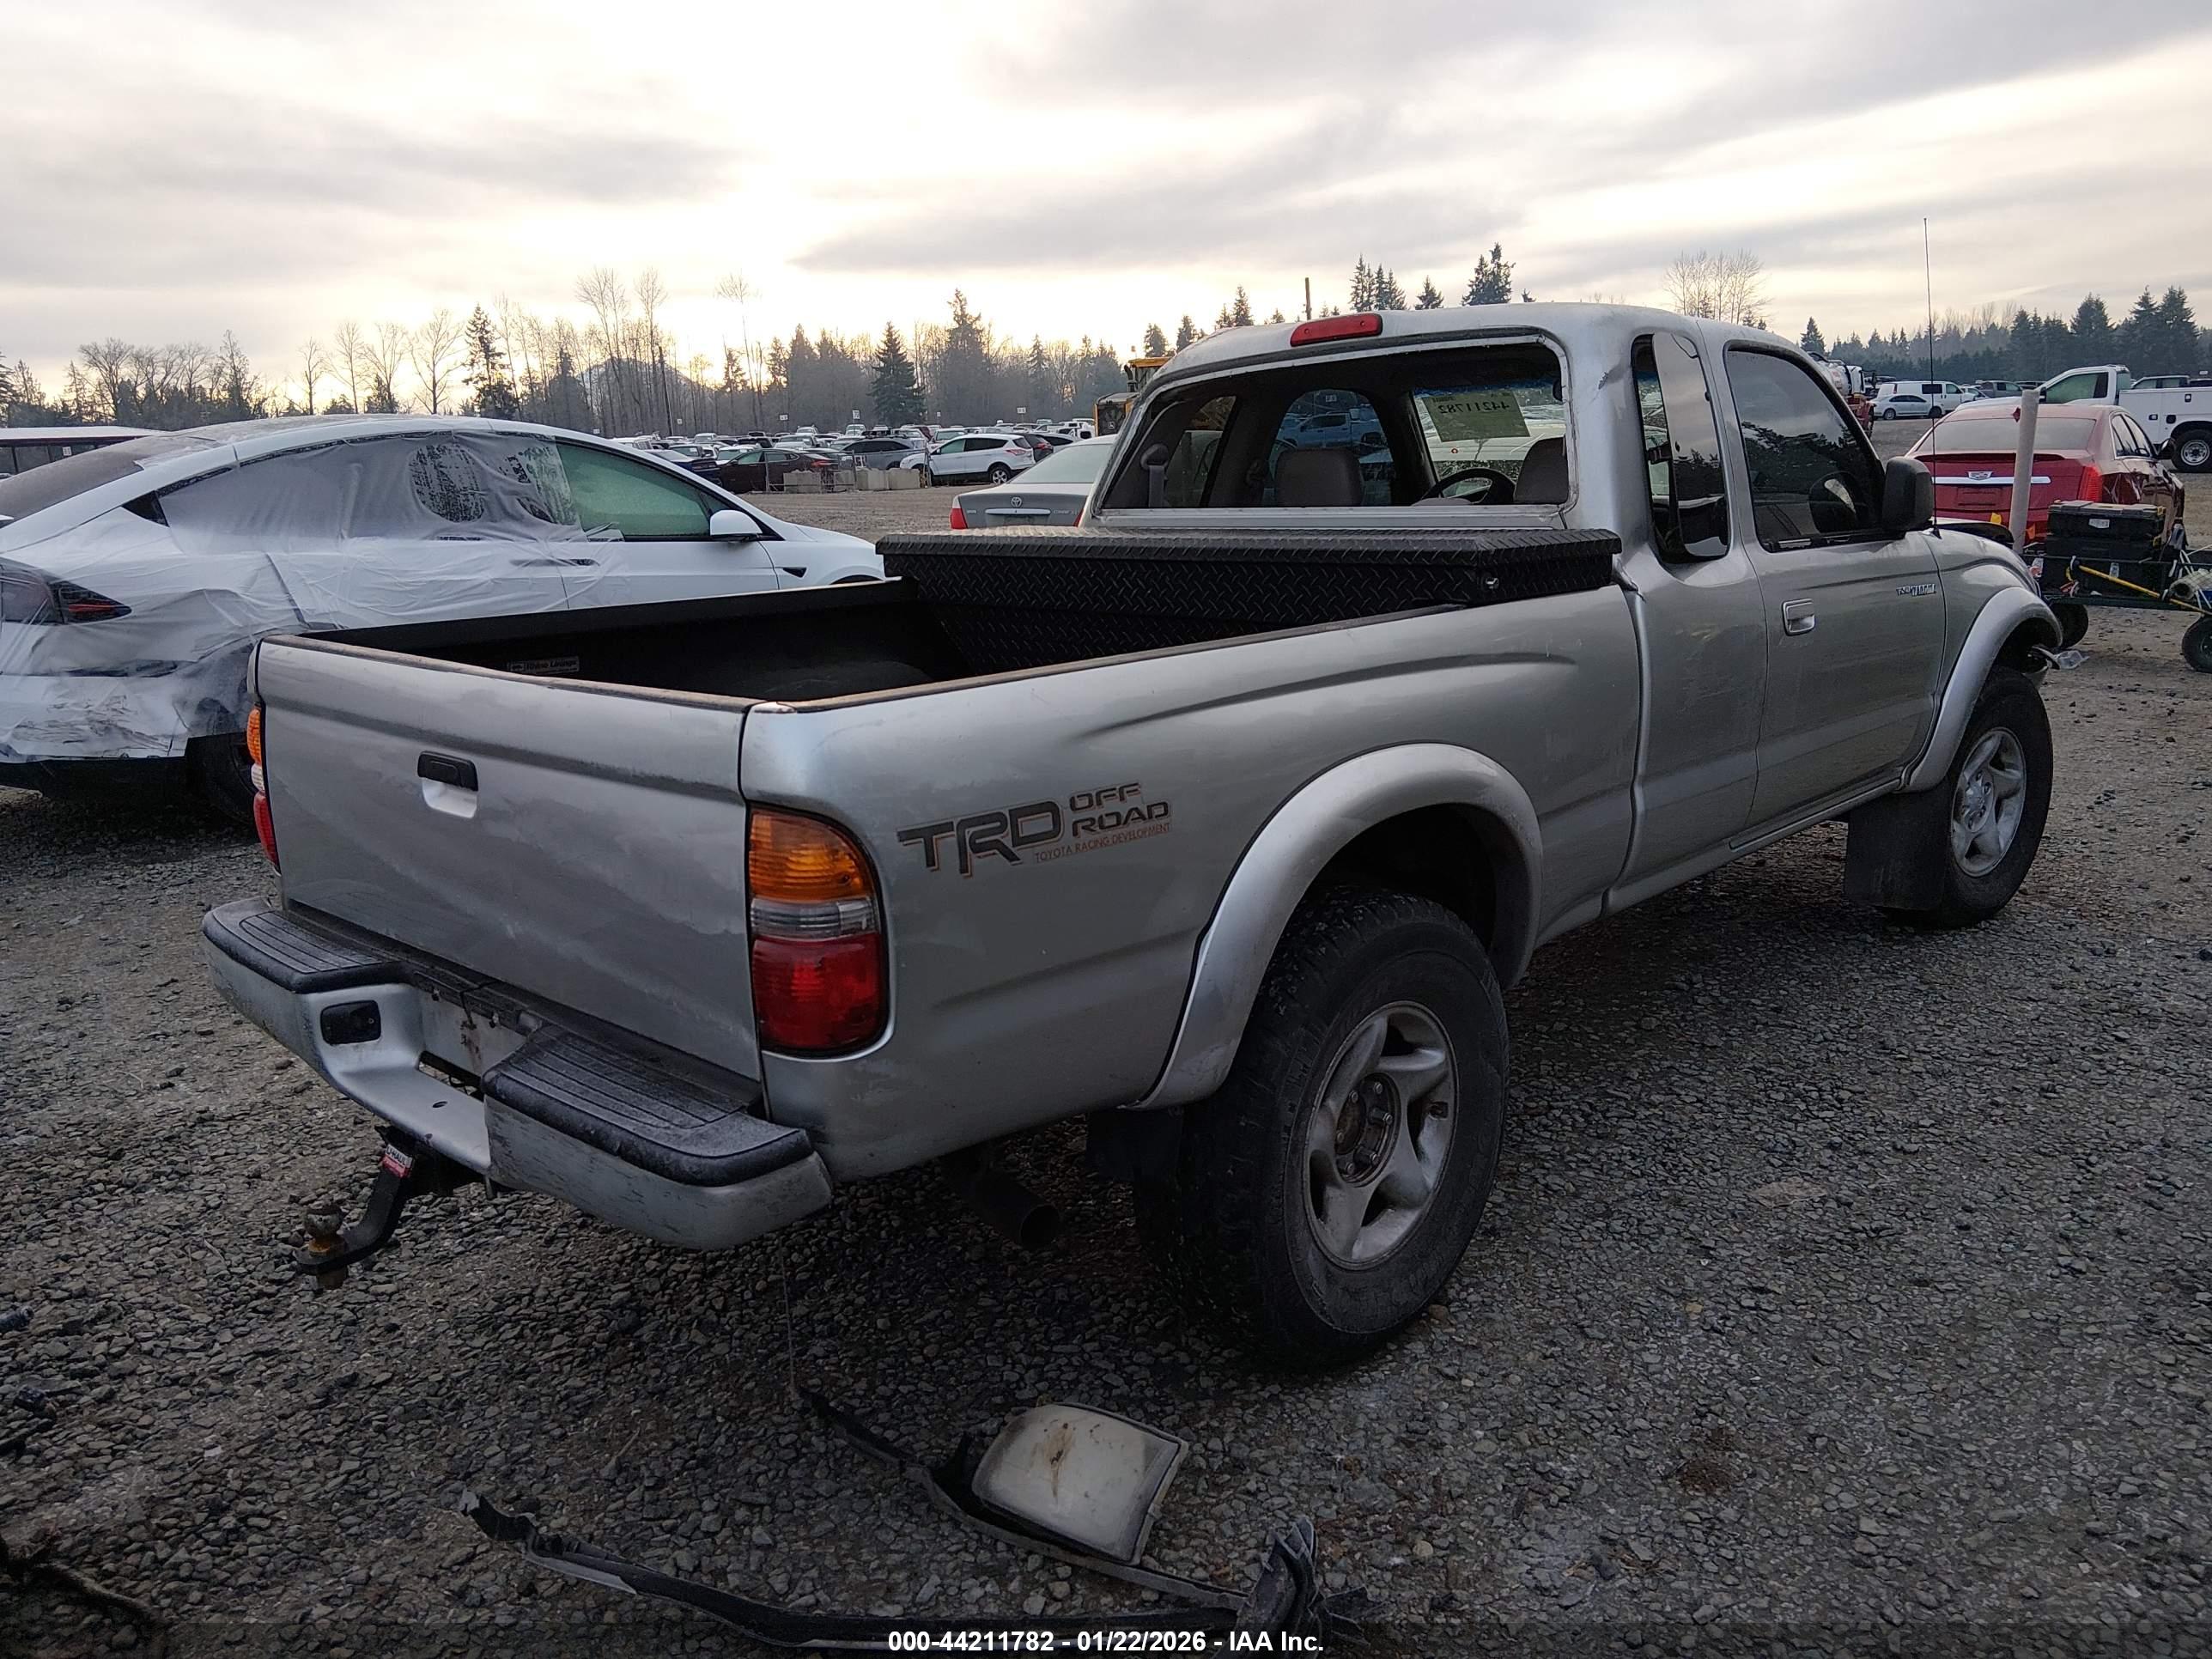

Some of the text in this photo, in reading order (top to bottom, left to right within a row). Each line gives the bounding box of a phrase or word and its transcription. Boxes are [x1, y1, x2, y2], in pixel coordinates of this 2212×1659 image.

[1069, 782, 1141, 812] OFF
[1072, 801, 1170, 837] ROAD
[896, 800, 1063, 878] TRD
[1035, 823, 1170, 863] TOYOTA RACING DEVELOPMENT
